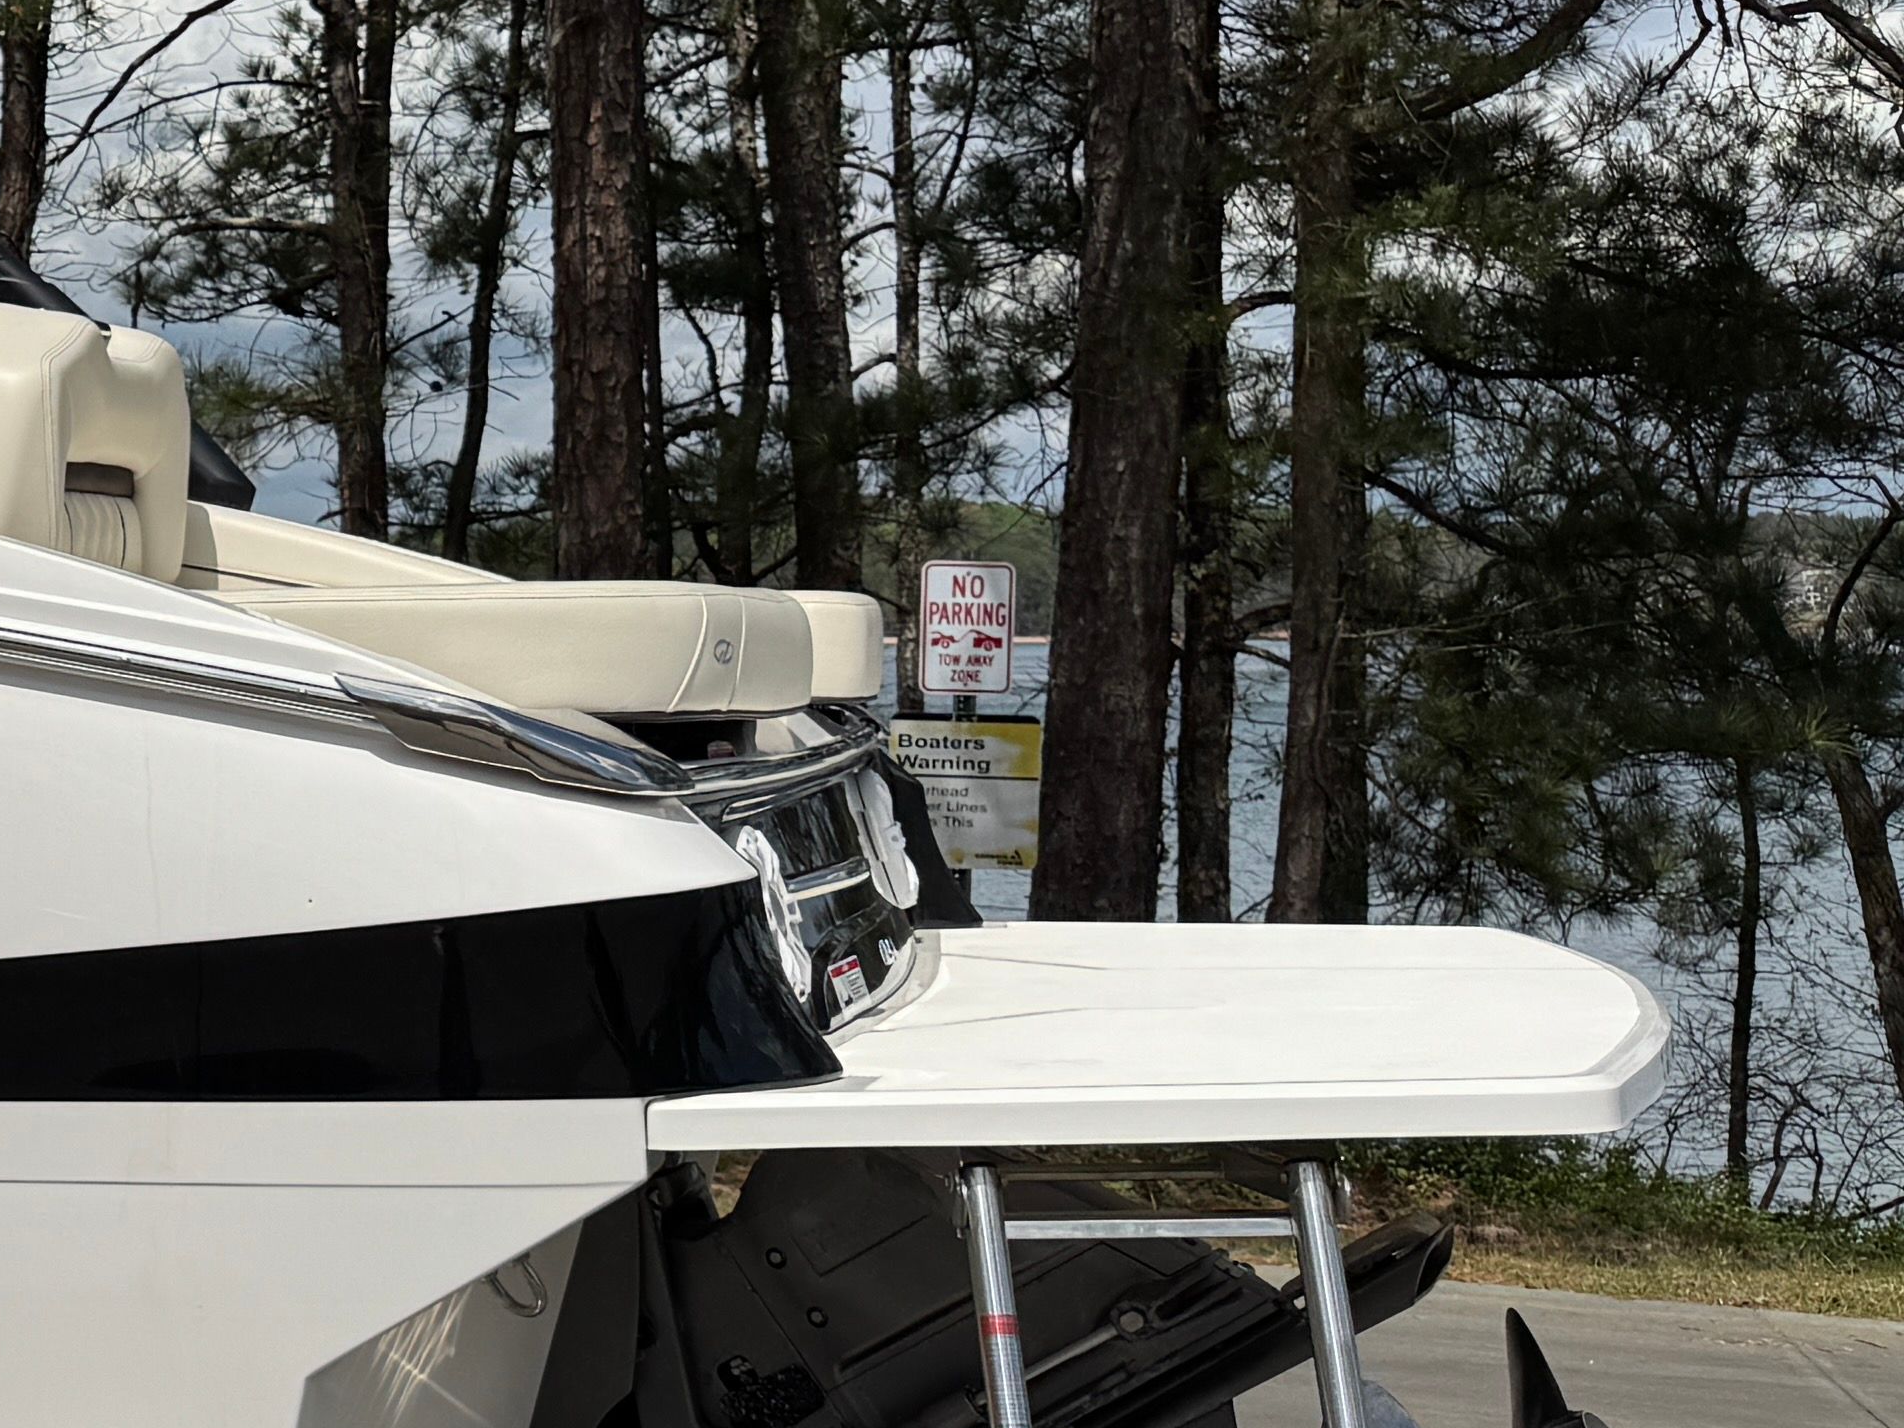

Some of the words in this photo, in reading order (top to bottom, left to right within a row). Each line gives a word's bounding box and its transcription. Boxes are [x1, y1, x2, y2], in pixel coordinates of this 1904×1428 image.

[952, 574, 985, 599] NO
[929, 602, 1006, 627] PARKING
[939, 654, 960, 667] TOW
[965, 654, 995, 668] AWAY
[950, 669, 982, 683] ZONE
[898, 733, 985, 751] Boaters
[896, 753, 991, 774] Warning
[944, 816, 974, 828] This
